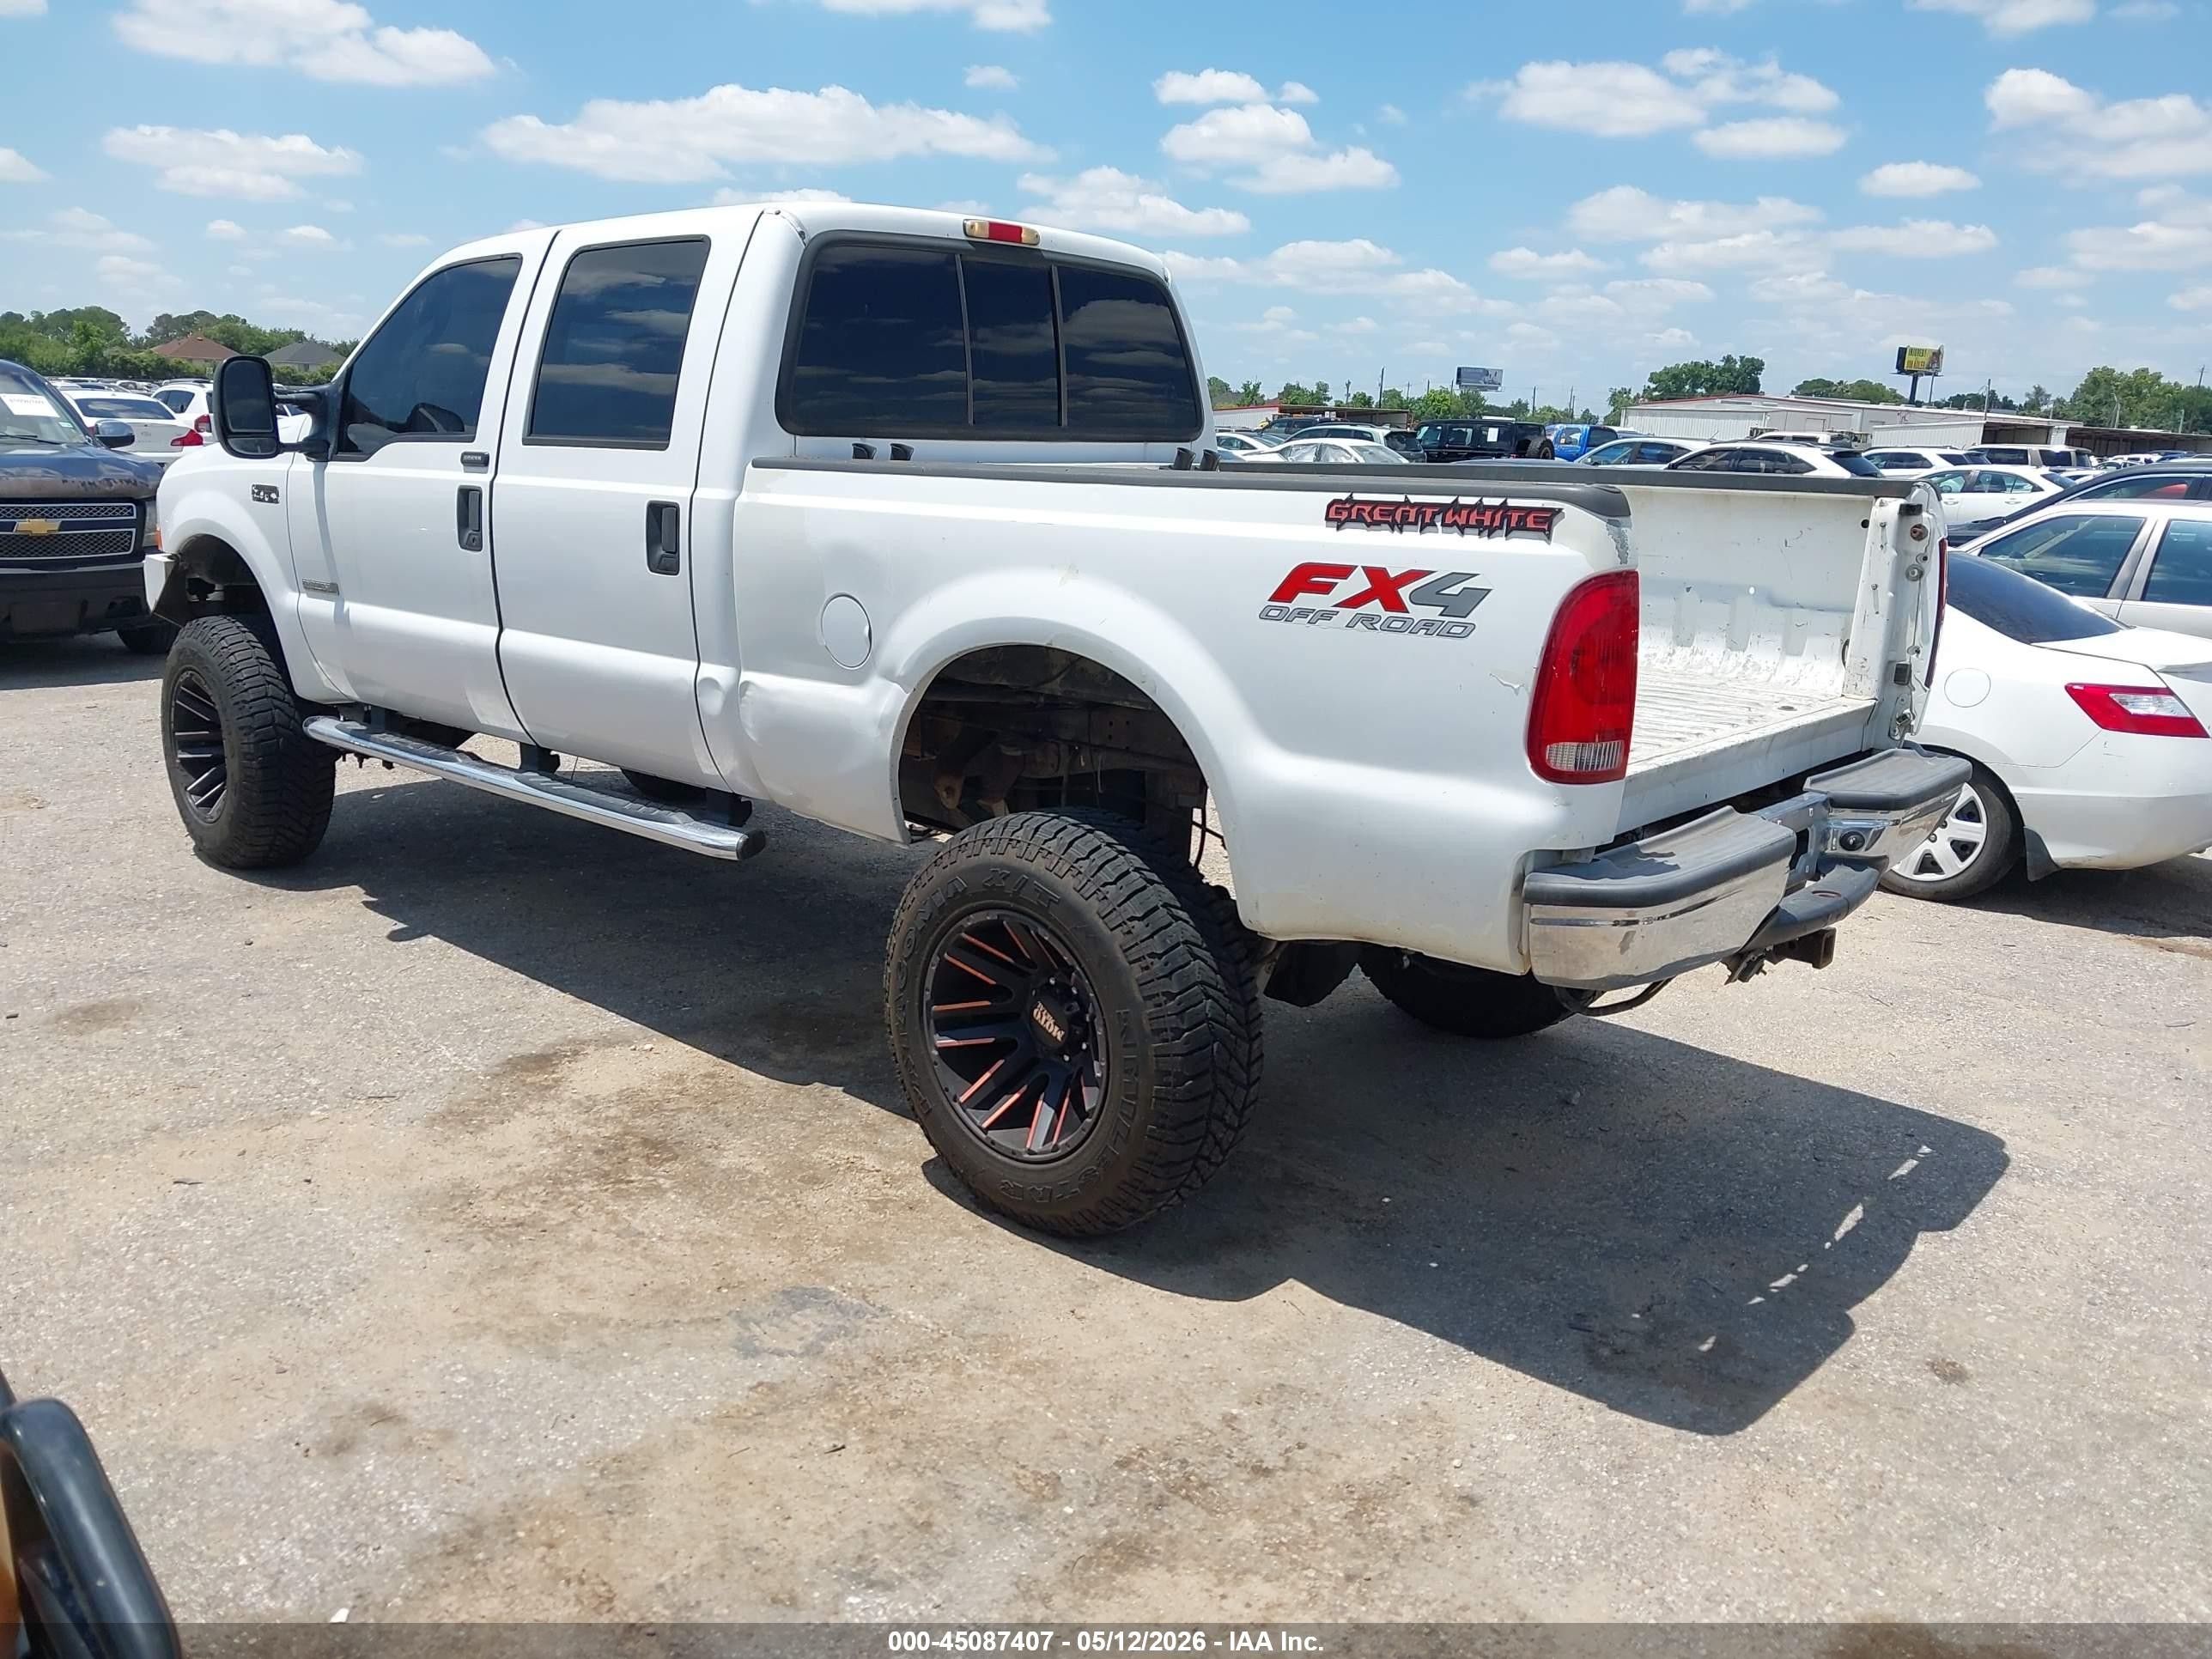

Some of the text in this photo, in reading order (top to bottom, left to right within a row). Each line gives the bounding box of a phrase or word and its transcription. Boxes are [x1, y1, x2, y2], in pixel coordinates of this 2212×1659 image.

[1441, 498, 1564, 538] WHITE
[1267, 562, 1492, 618] FX4
[1258, 605, 1476, 638] OFF ROAD
